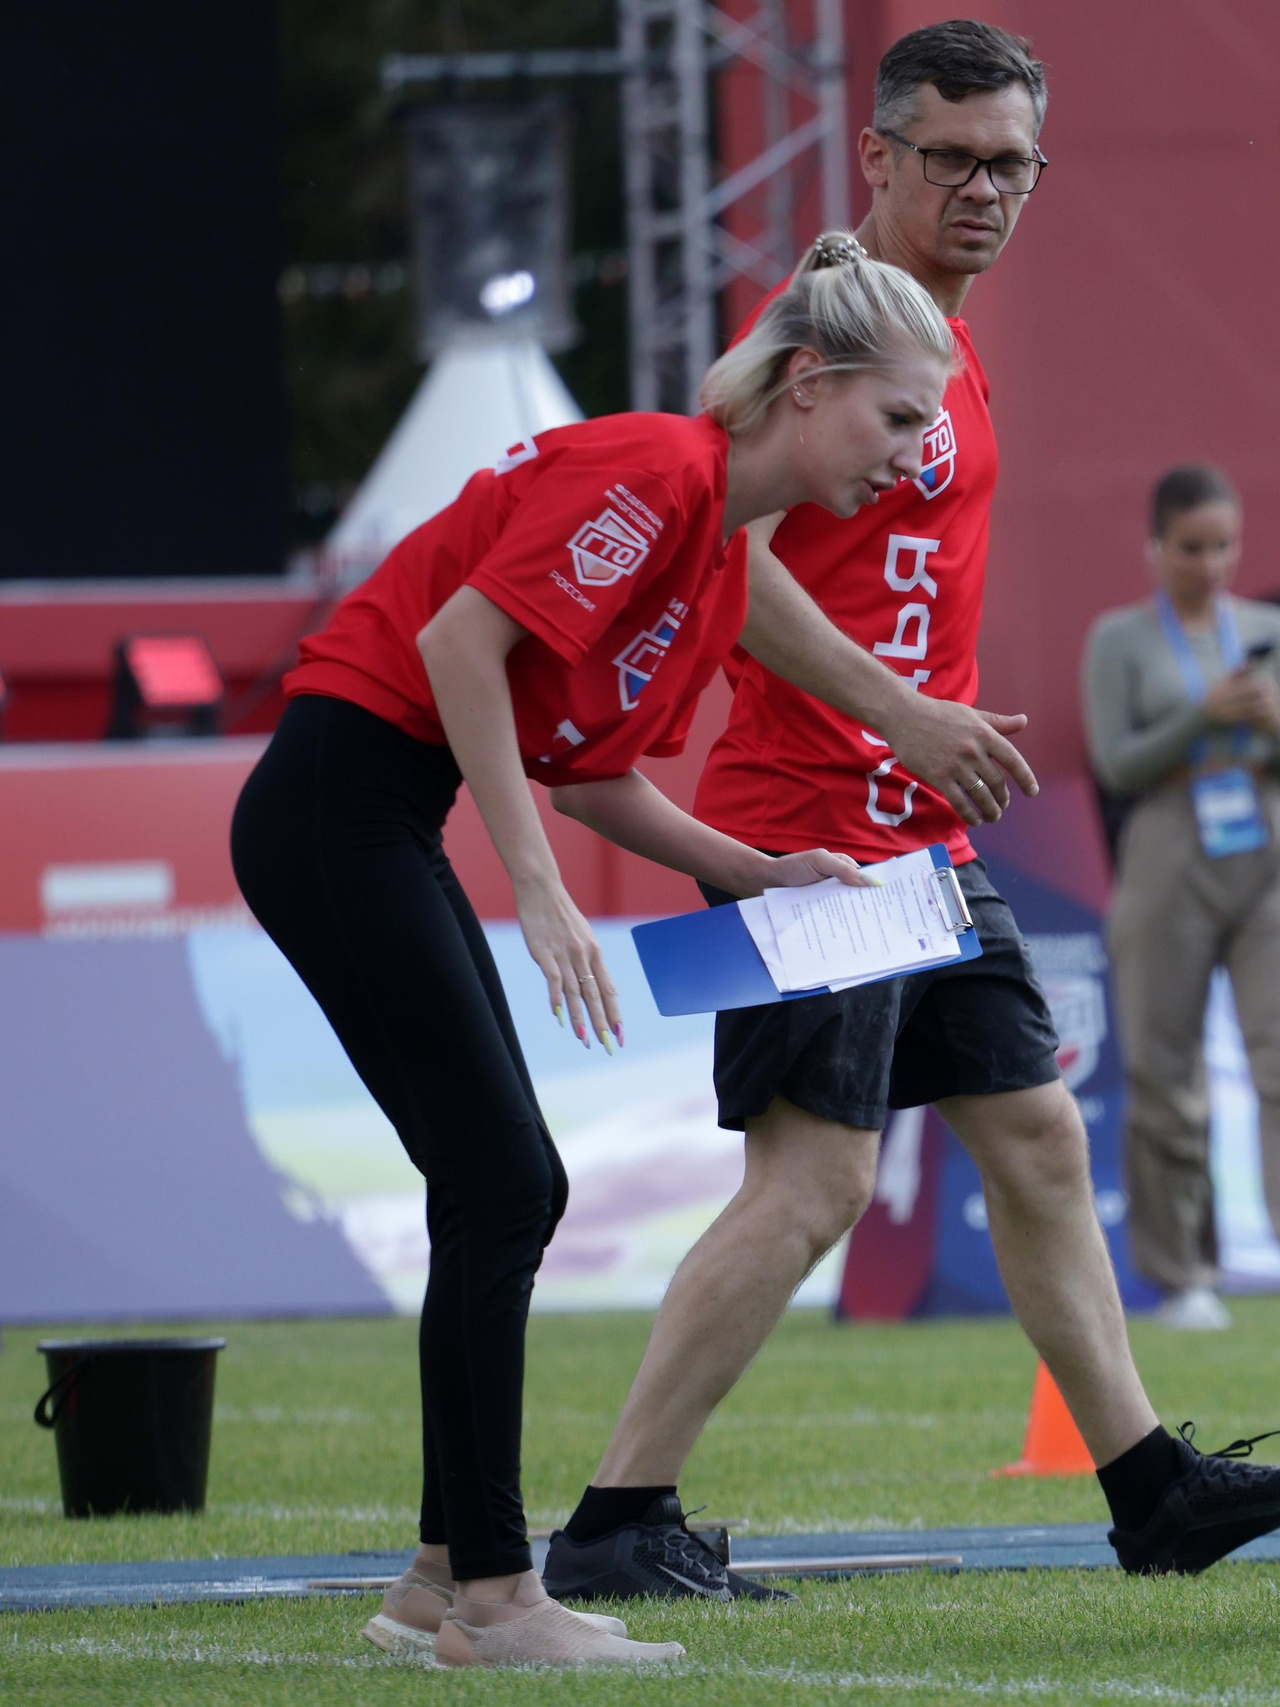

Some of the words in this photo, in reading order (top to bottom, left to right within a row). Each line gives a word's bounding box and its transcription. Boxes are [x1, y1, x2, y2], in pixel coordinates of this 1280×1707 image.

[924, 425, 951, 459] ТО
[580, 530, 637, 566] ГТО
[861, 534, 941, 827] СЬЯ
